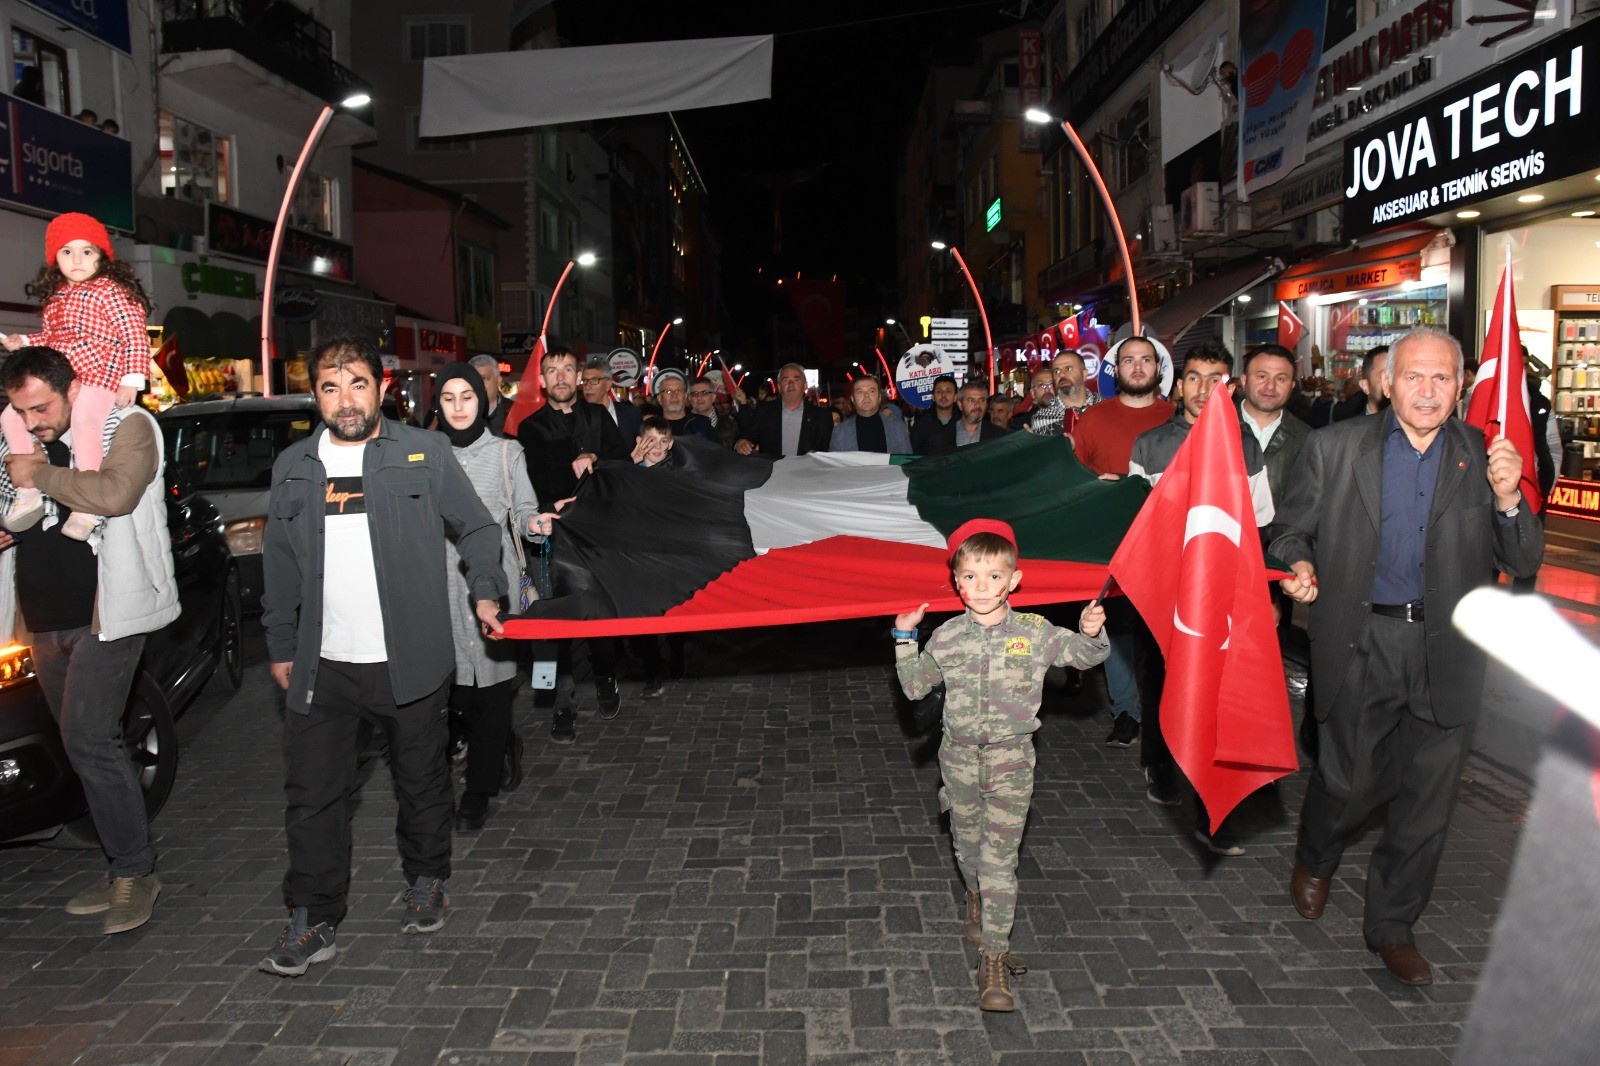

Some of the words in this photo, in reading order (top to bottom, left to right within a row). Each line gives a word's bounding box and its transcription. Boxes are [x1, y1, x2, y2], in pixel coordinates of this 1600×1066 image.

[1022, 39, 1037, 140] KUAFR
[1333, 36, 1375, 96] HALK
[1348, 55, 1432, 119] BAŞKANLIĞI
[1346, 115, 1437, 199] JOVA
[1443, 46, 1584, 160] TECH
[22, 136, 84, 179] sigorta
[1254, 151, 1282, 176] CHP
[1372, 190, 1429, 225] AKSESUAR
[1430, 190, 1440, 206] &
[1440, 168, 1488, 203] TEKNİK
[1489, 149, 1545, 188] SERVİS
[1345, 269, 1388, 288] MARKET
